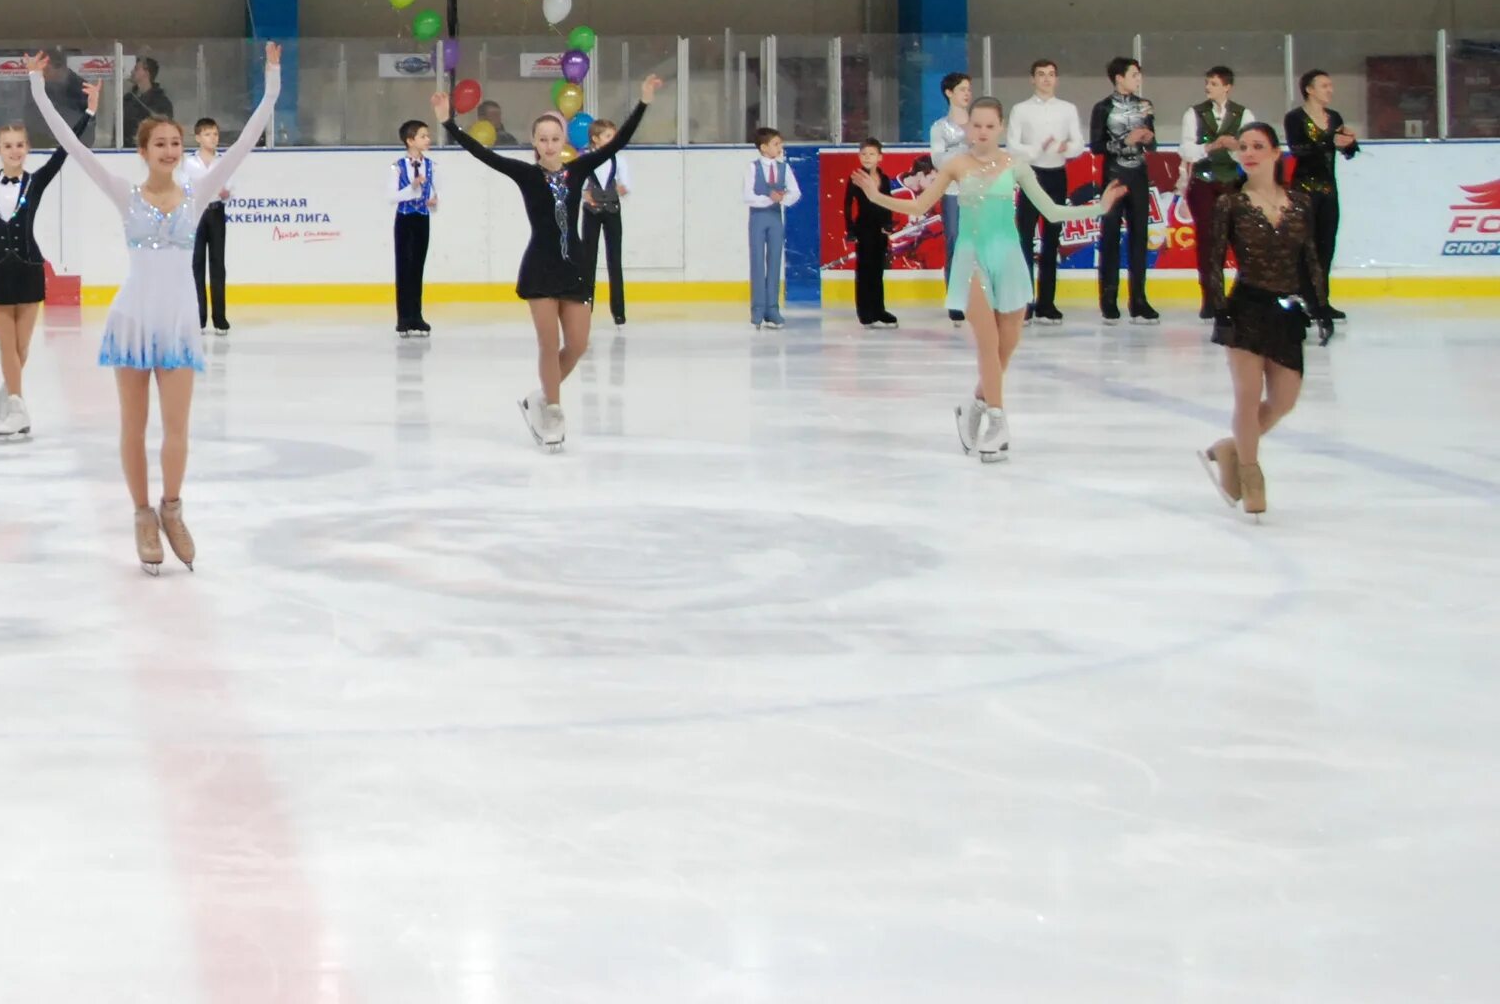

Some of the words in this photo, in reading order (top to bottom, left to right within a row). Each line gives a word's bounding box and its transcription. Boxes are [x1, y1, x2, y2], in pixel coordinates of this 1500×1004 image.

[225, 198, 308, 209] ЛОДЕЖНАЯ
[295, 214, 331, 223] ЛИГА
[1444, 242, 1500, 254] СПОР
